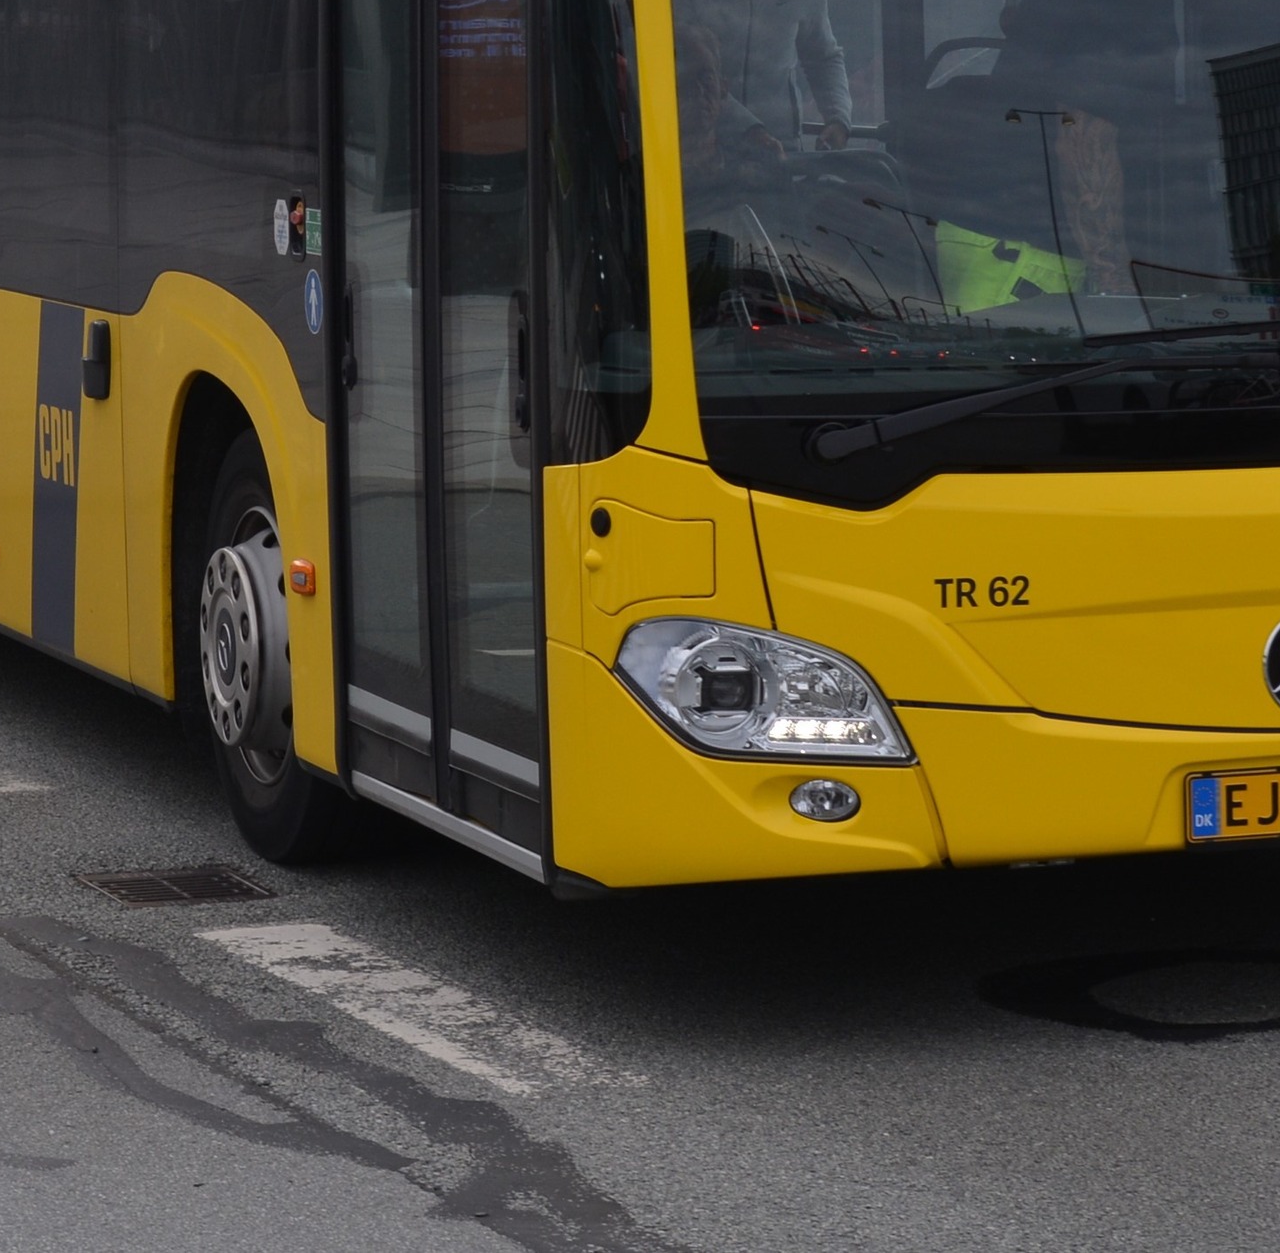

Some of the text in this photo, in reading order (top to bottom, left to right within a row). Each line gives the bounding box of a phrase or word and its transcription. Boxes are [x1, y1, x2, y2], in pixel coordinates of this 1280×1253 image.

[38, 402, 75, 488] CPH
[934, 575, 1030, 608] TR 62
[1194, 813, 1214, 828] DK
[1224, 781, 1280, 827] EJ
